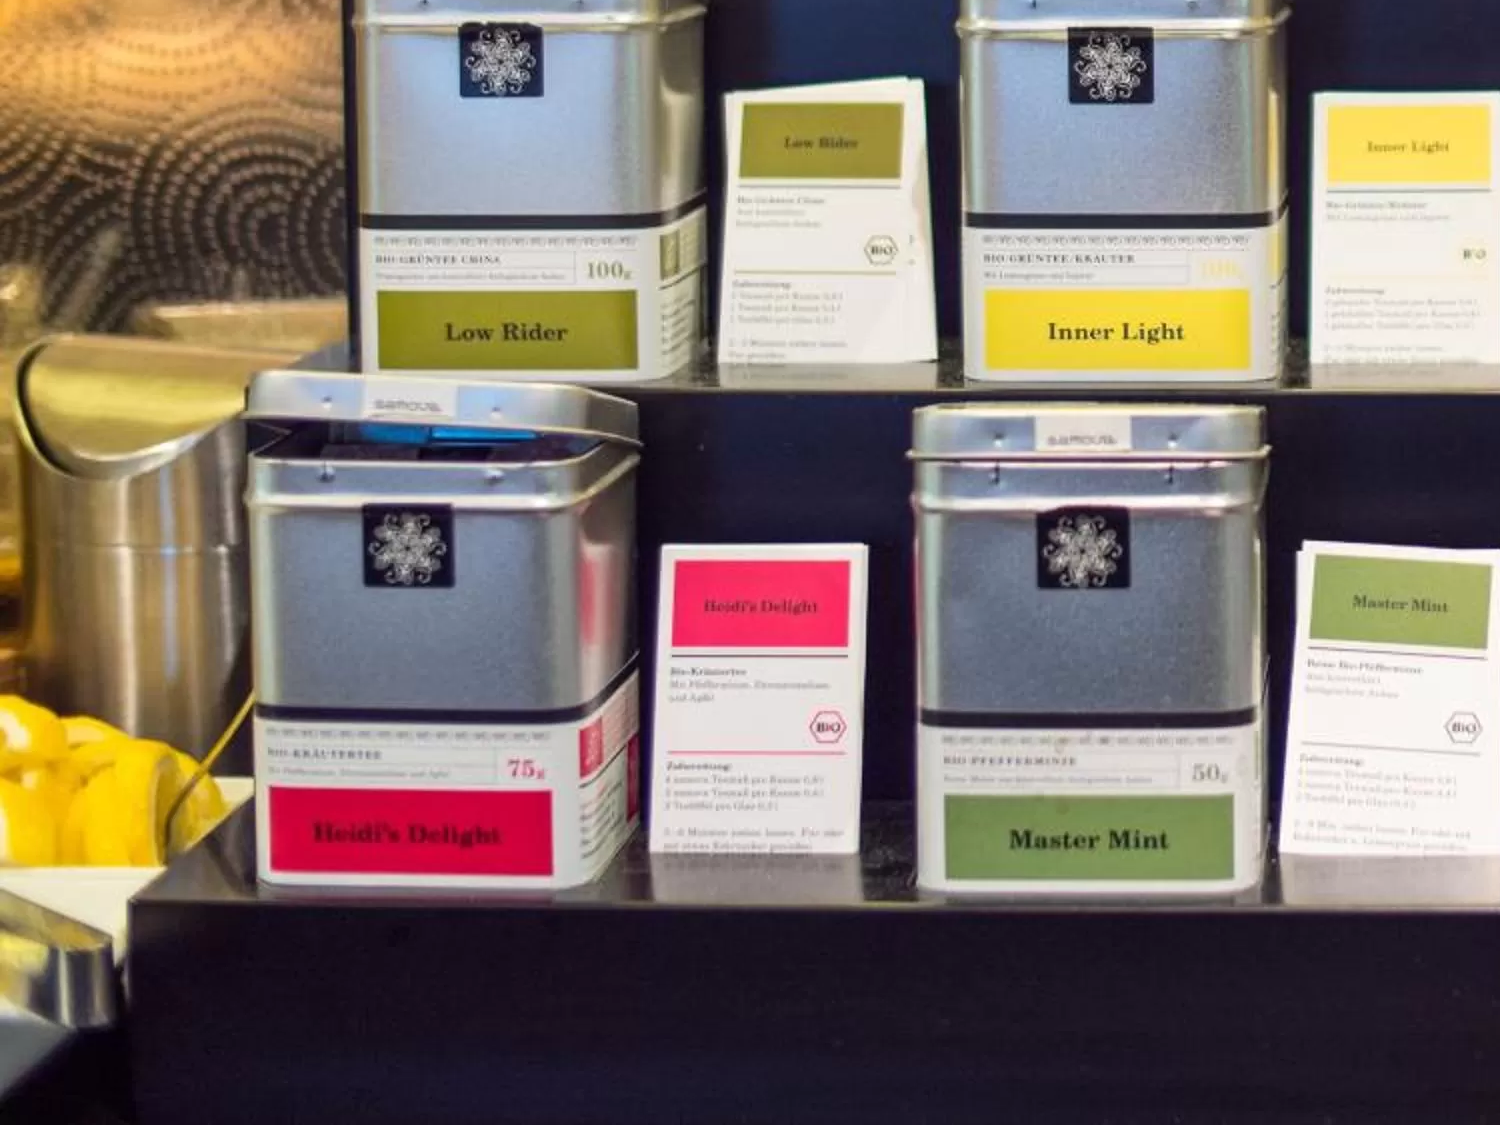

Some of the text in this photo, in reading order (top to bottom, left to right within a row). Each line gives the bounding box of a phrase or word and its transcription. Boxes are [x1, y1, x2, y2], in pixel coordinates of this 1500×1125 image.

[784, 138, 815, 149] Low
[1367, 140, 1450, 154] Inner Light
[587, 261, 632, 281] 100g
[444, 322, 569, 342] Low Rider
[1048, 322, 1185, 344] Inner Light
[704, 599, 818, 615] Heidi's Delight
[1352, 594, 1449, 613] Master Mint
[311, 820, 503, 849] Heidi's Delight
[1009, 829, 1170, 851] Master Mint
